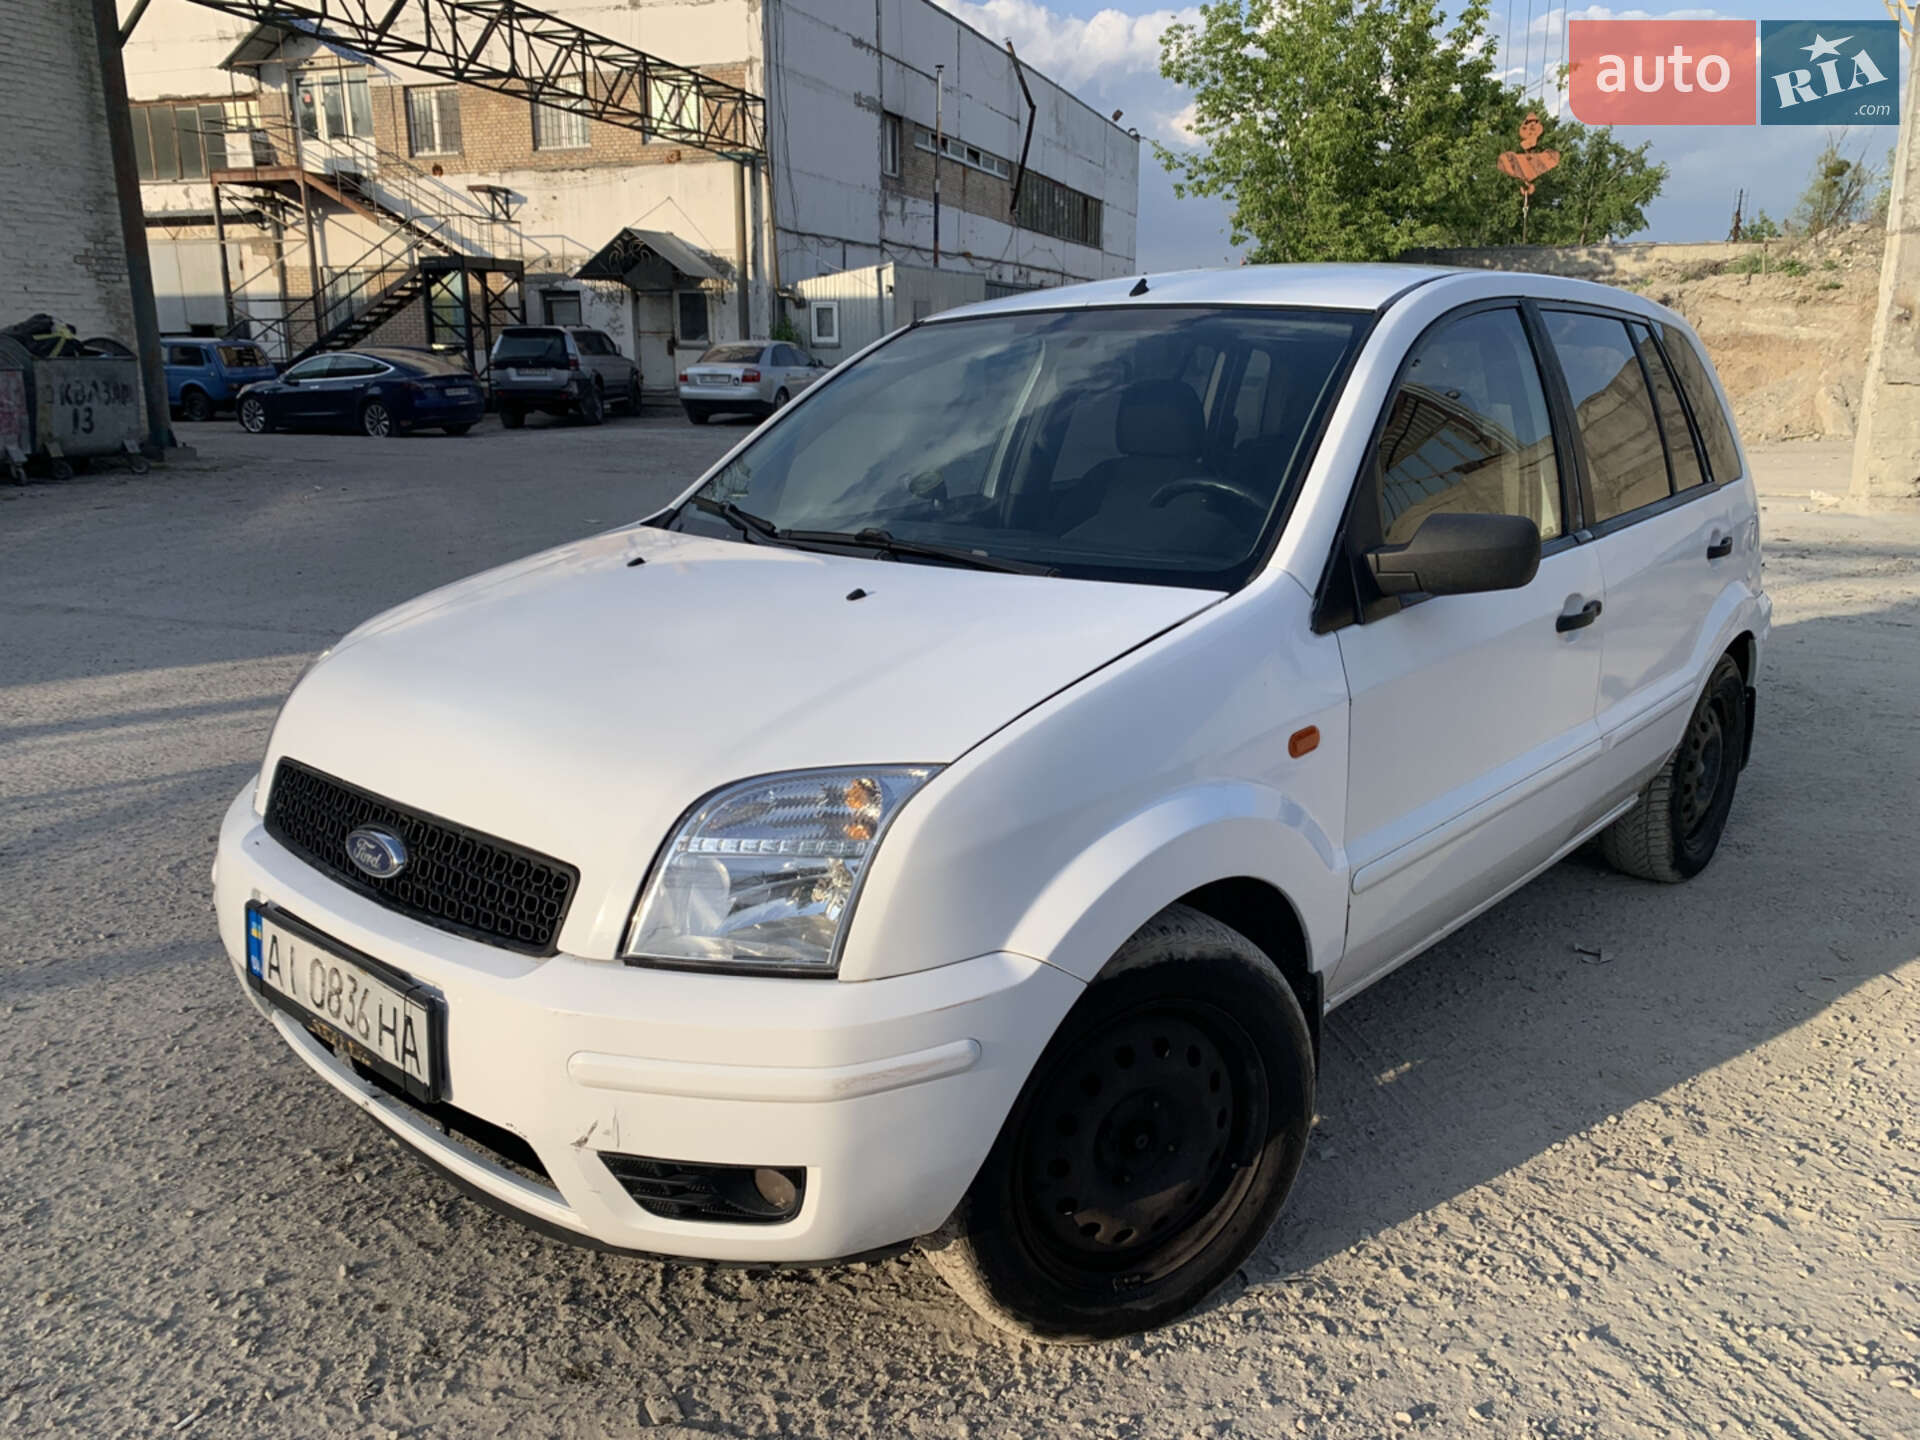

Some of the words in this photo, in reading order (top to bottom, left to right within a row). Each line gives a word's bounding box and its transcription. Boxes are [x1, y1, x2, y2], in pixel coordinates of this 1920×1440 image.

[72, 407, 95, 435] 13
[353, 839, 382, 869] Ford
[267, 934, 297, 995] AI
[310, 957, 370, 1041] 0836
[378, 1003, 422, 1075] HA
